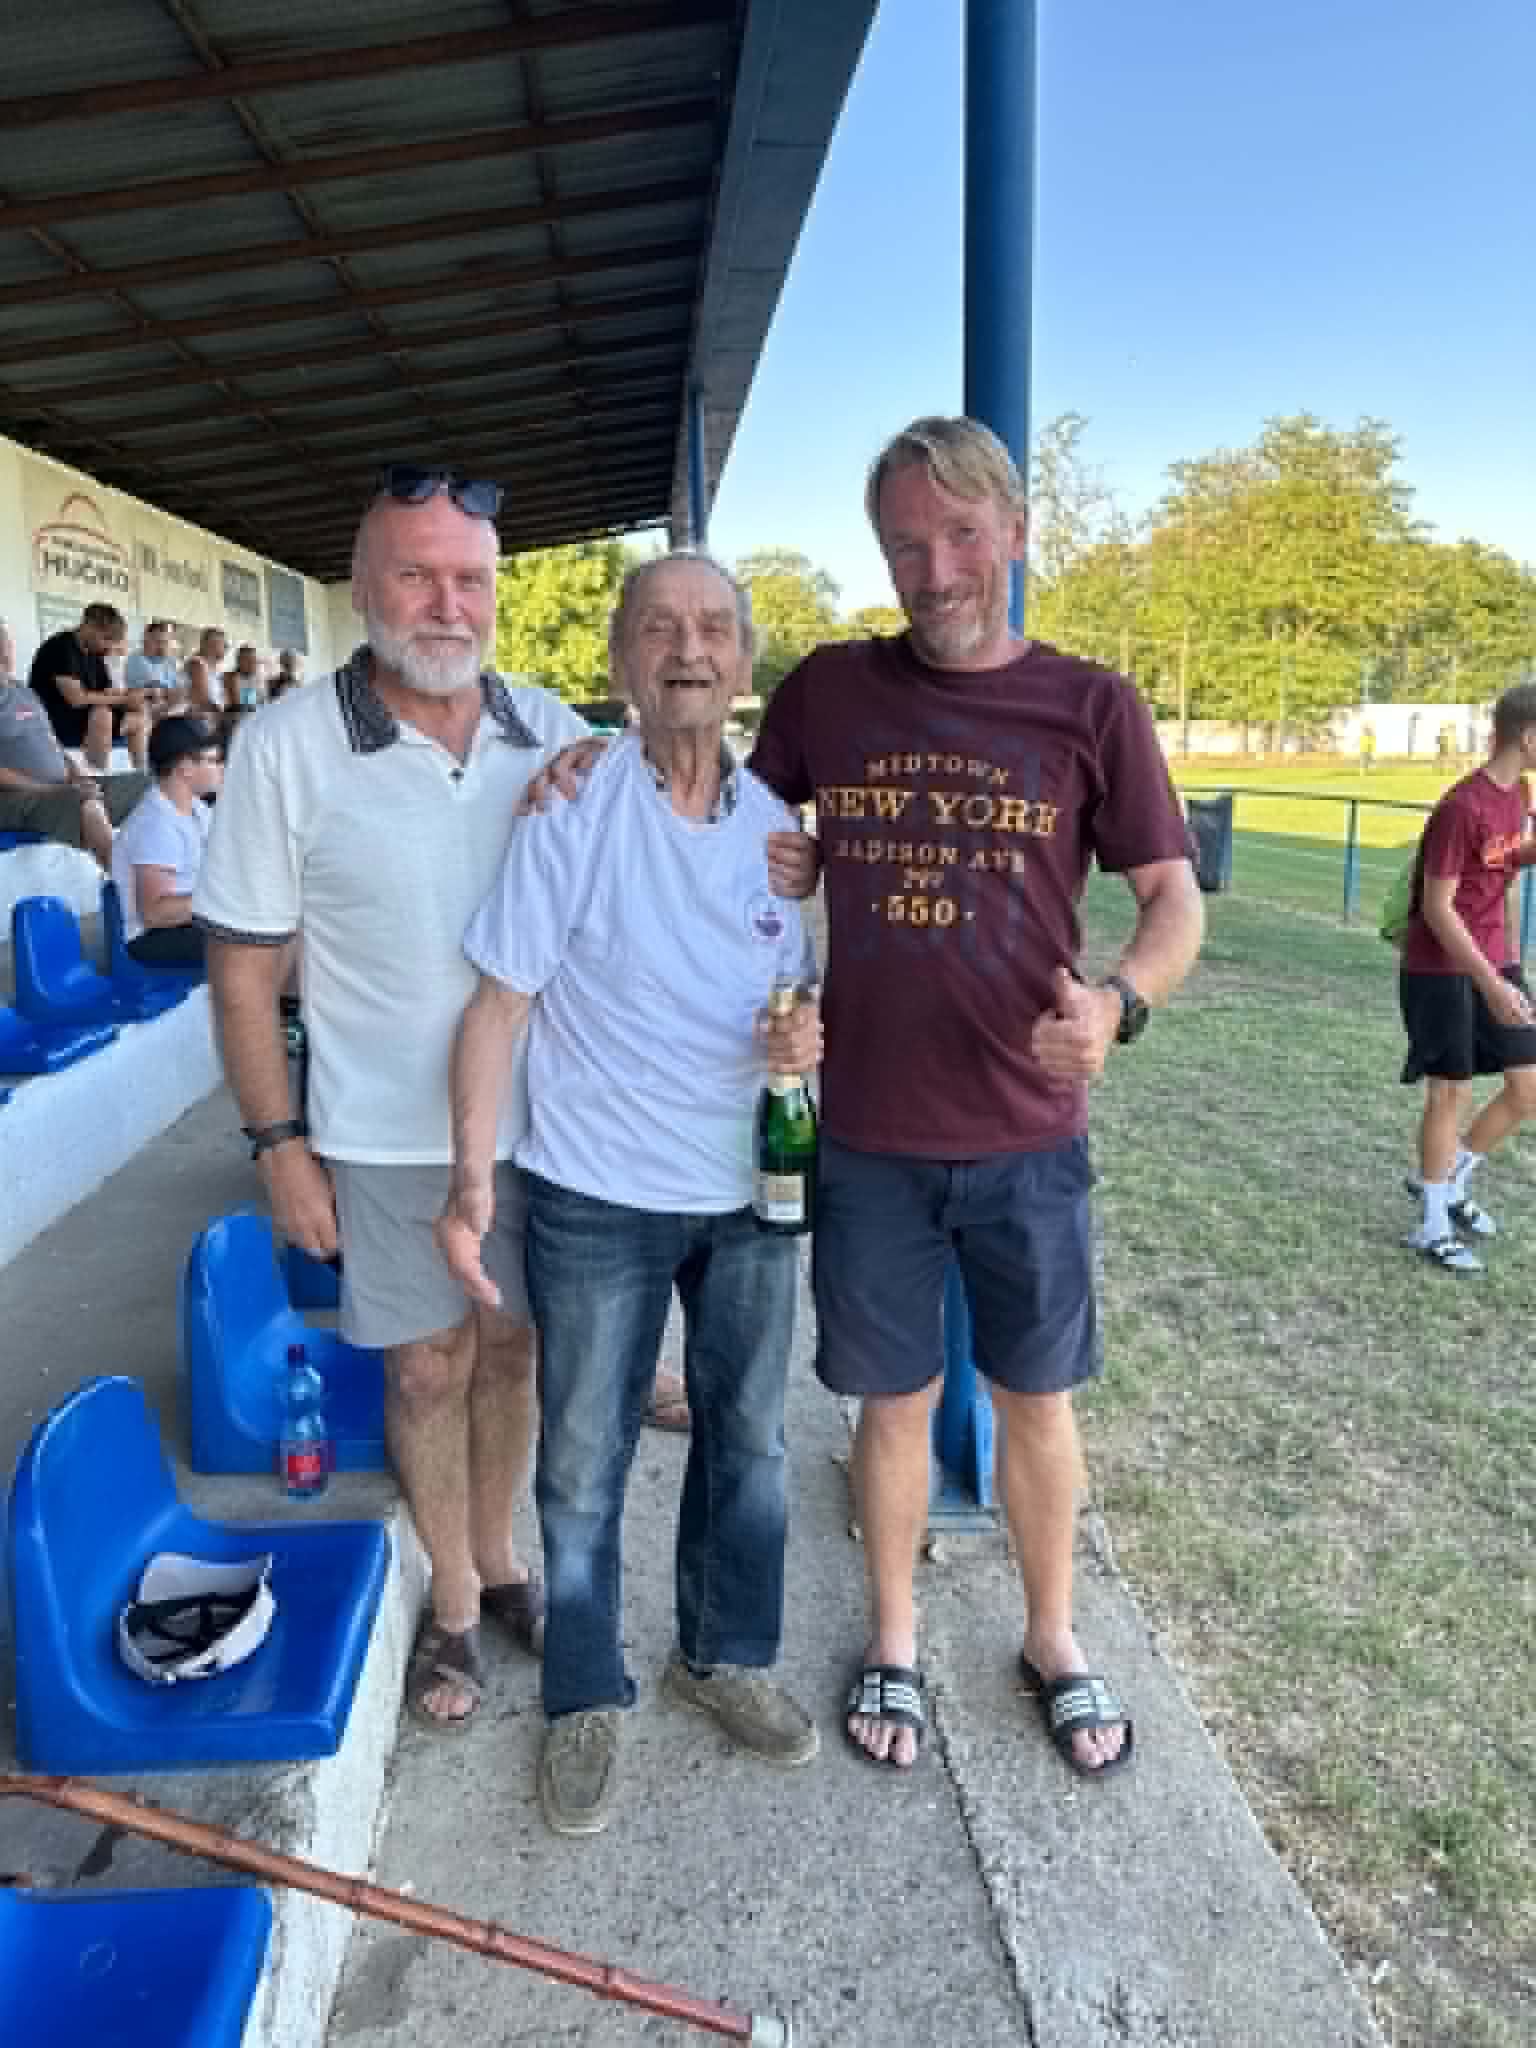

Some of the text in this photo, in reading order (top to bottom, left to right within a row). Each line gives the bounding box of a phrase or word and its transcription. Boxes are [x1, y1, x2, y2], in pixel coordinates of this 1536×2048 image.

[866, 753, 1010, 786] MIDTOWN
[817, 787, 1060, 838] NEW YORK
